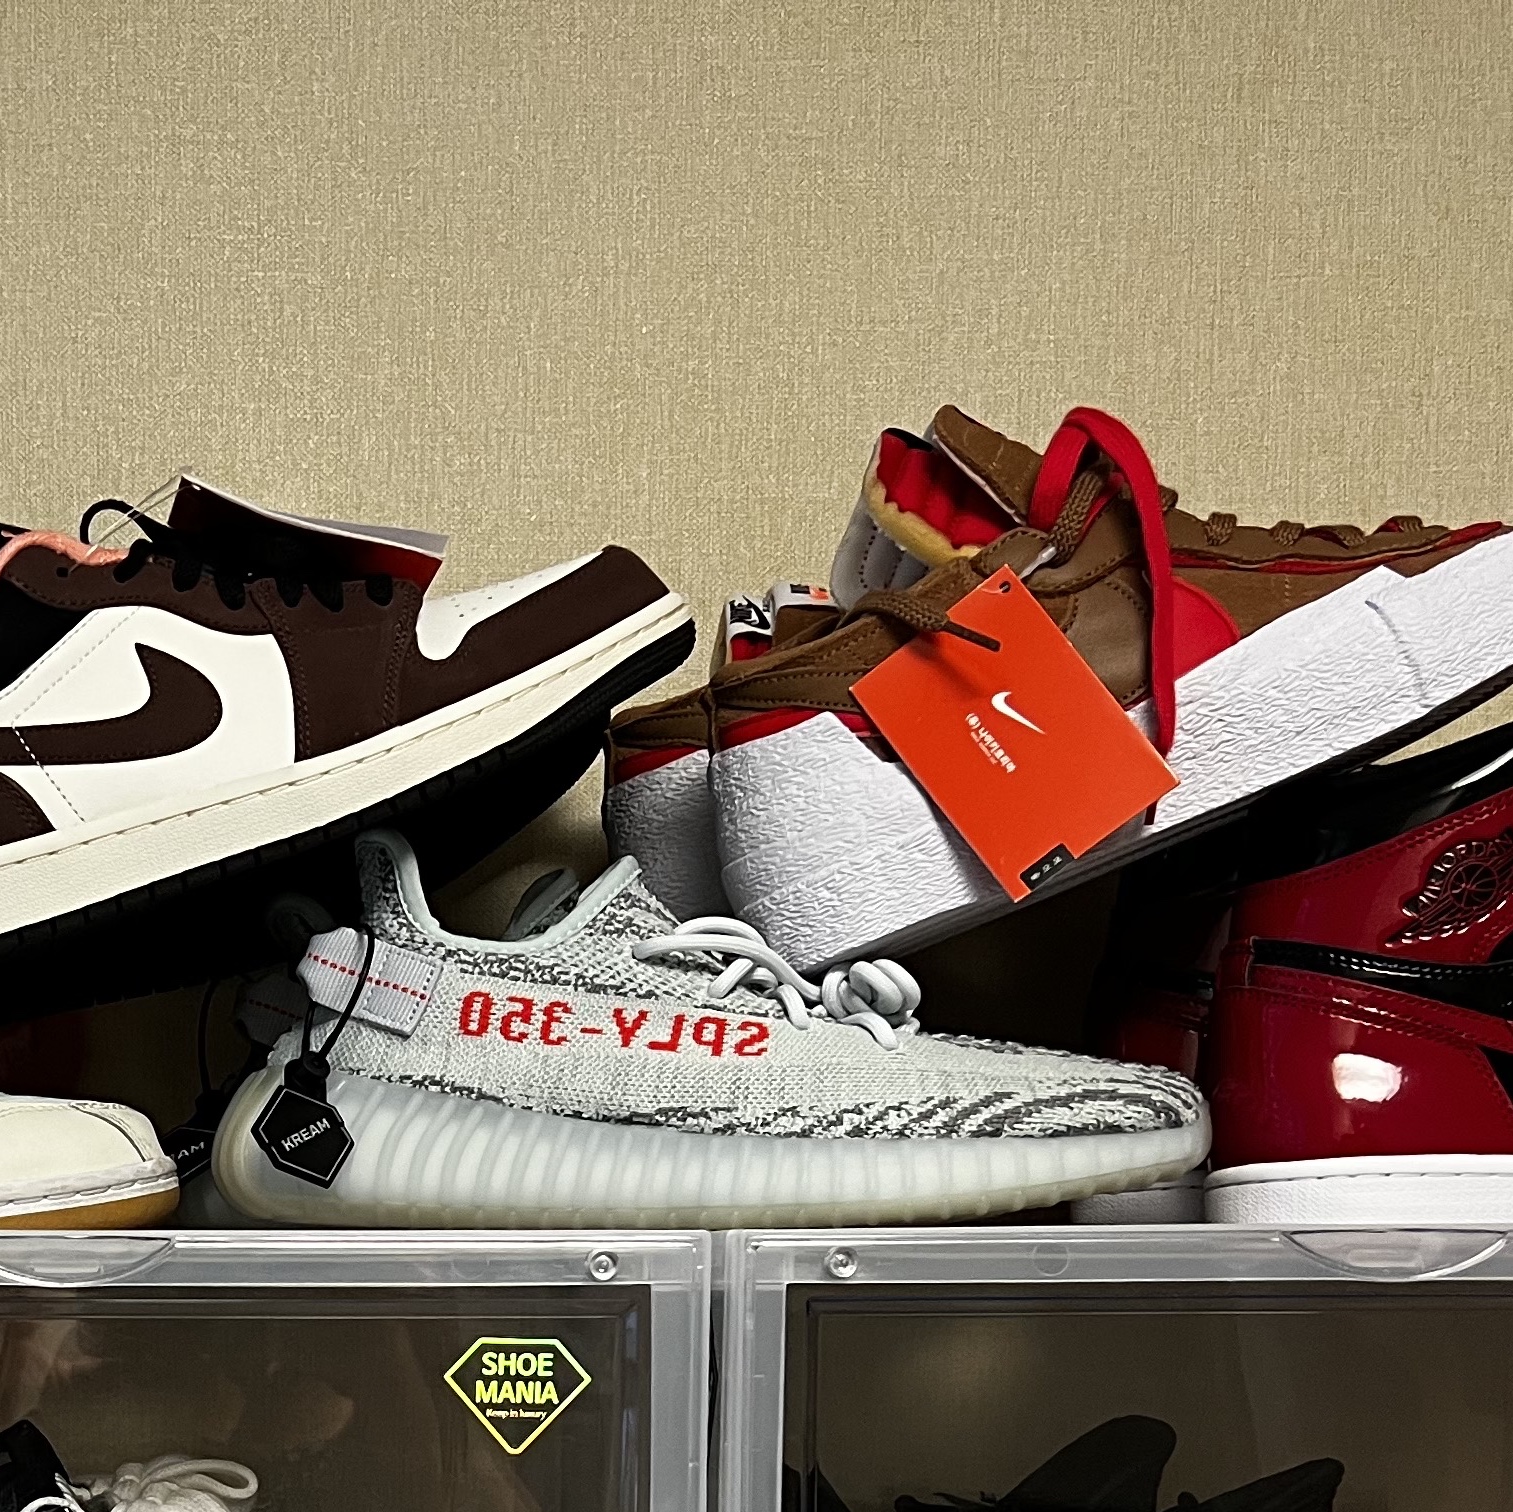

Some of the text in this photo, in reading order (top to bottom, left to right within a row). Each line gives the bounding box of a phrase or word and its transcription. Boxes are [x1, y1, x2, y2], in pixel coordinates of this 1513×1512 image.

[280, 1117, 331, 1152] KREAM
[481, 1351, 554, 1377] SHOE
[475, 1379, 560, 1405] MANIA
